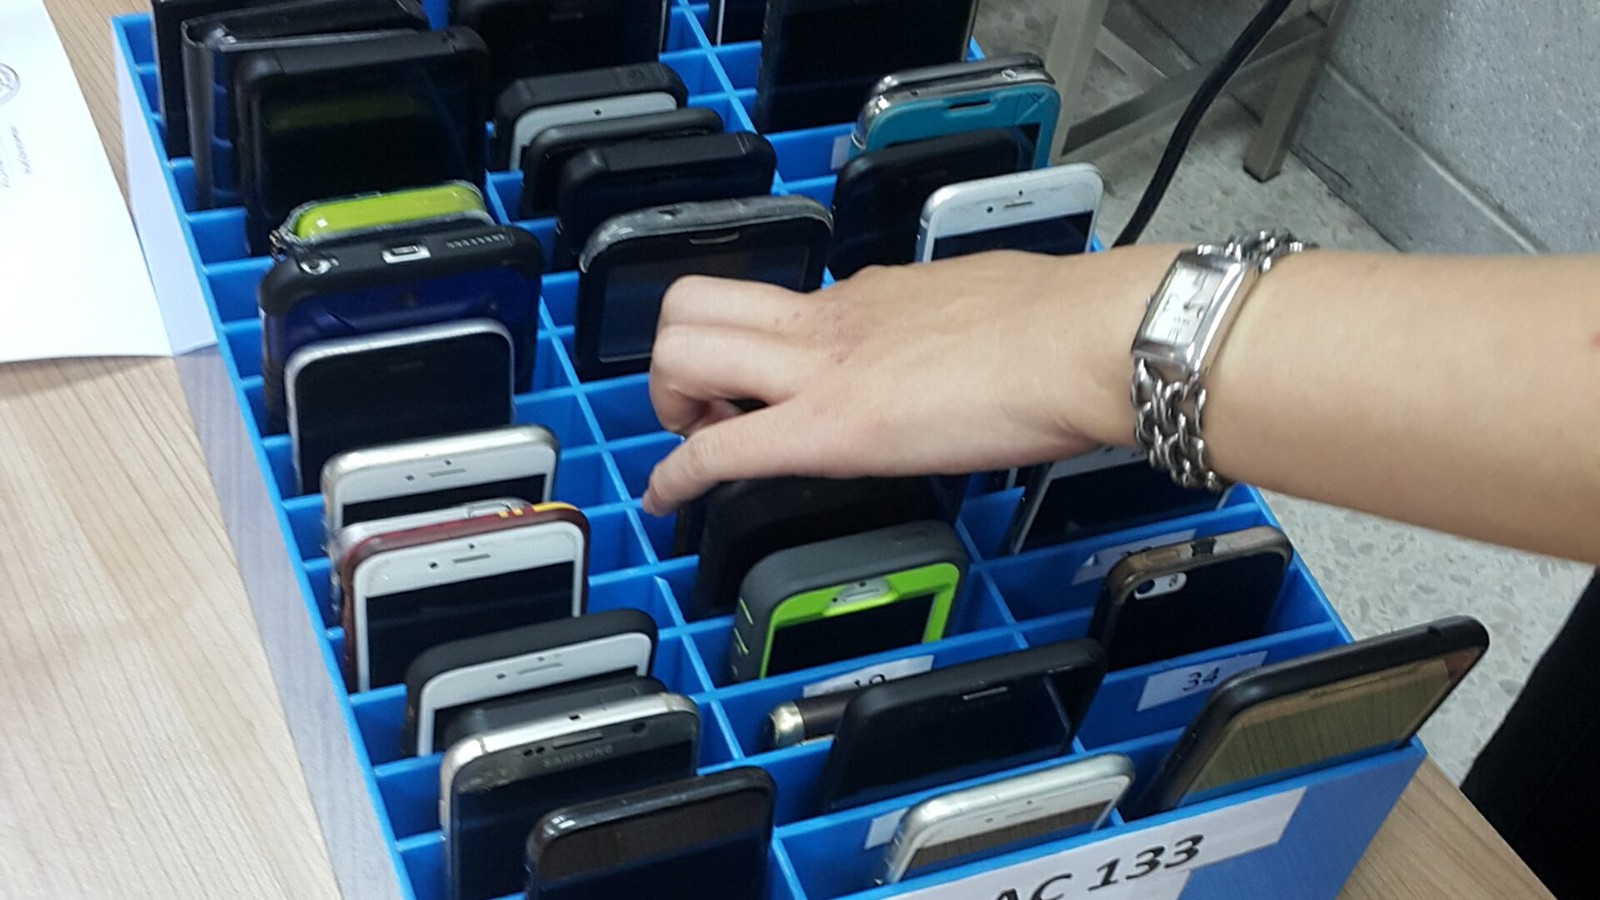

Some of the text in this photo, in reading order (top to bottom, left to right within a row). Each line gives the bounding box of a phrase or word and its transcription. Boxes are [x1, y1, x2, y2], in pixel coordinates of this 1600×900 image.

[1182, 667, 1220, 692] 34
[543, 744, 613, 768] SAMSUNG
[1088, 834, 1204, 891] 133
